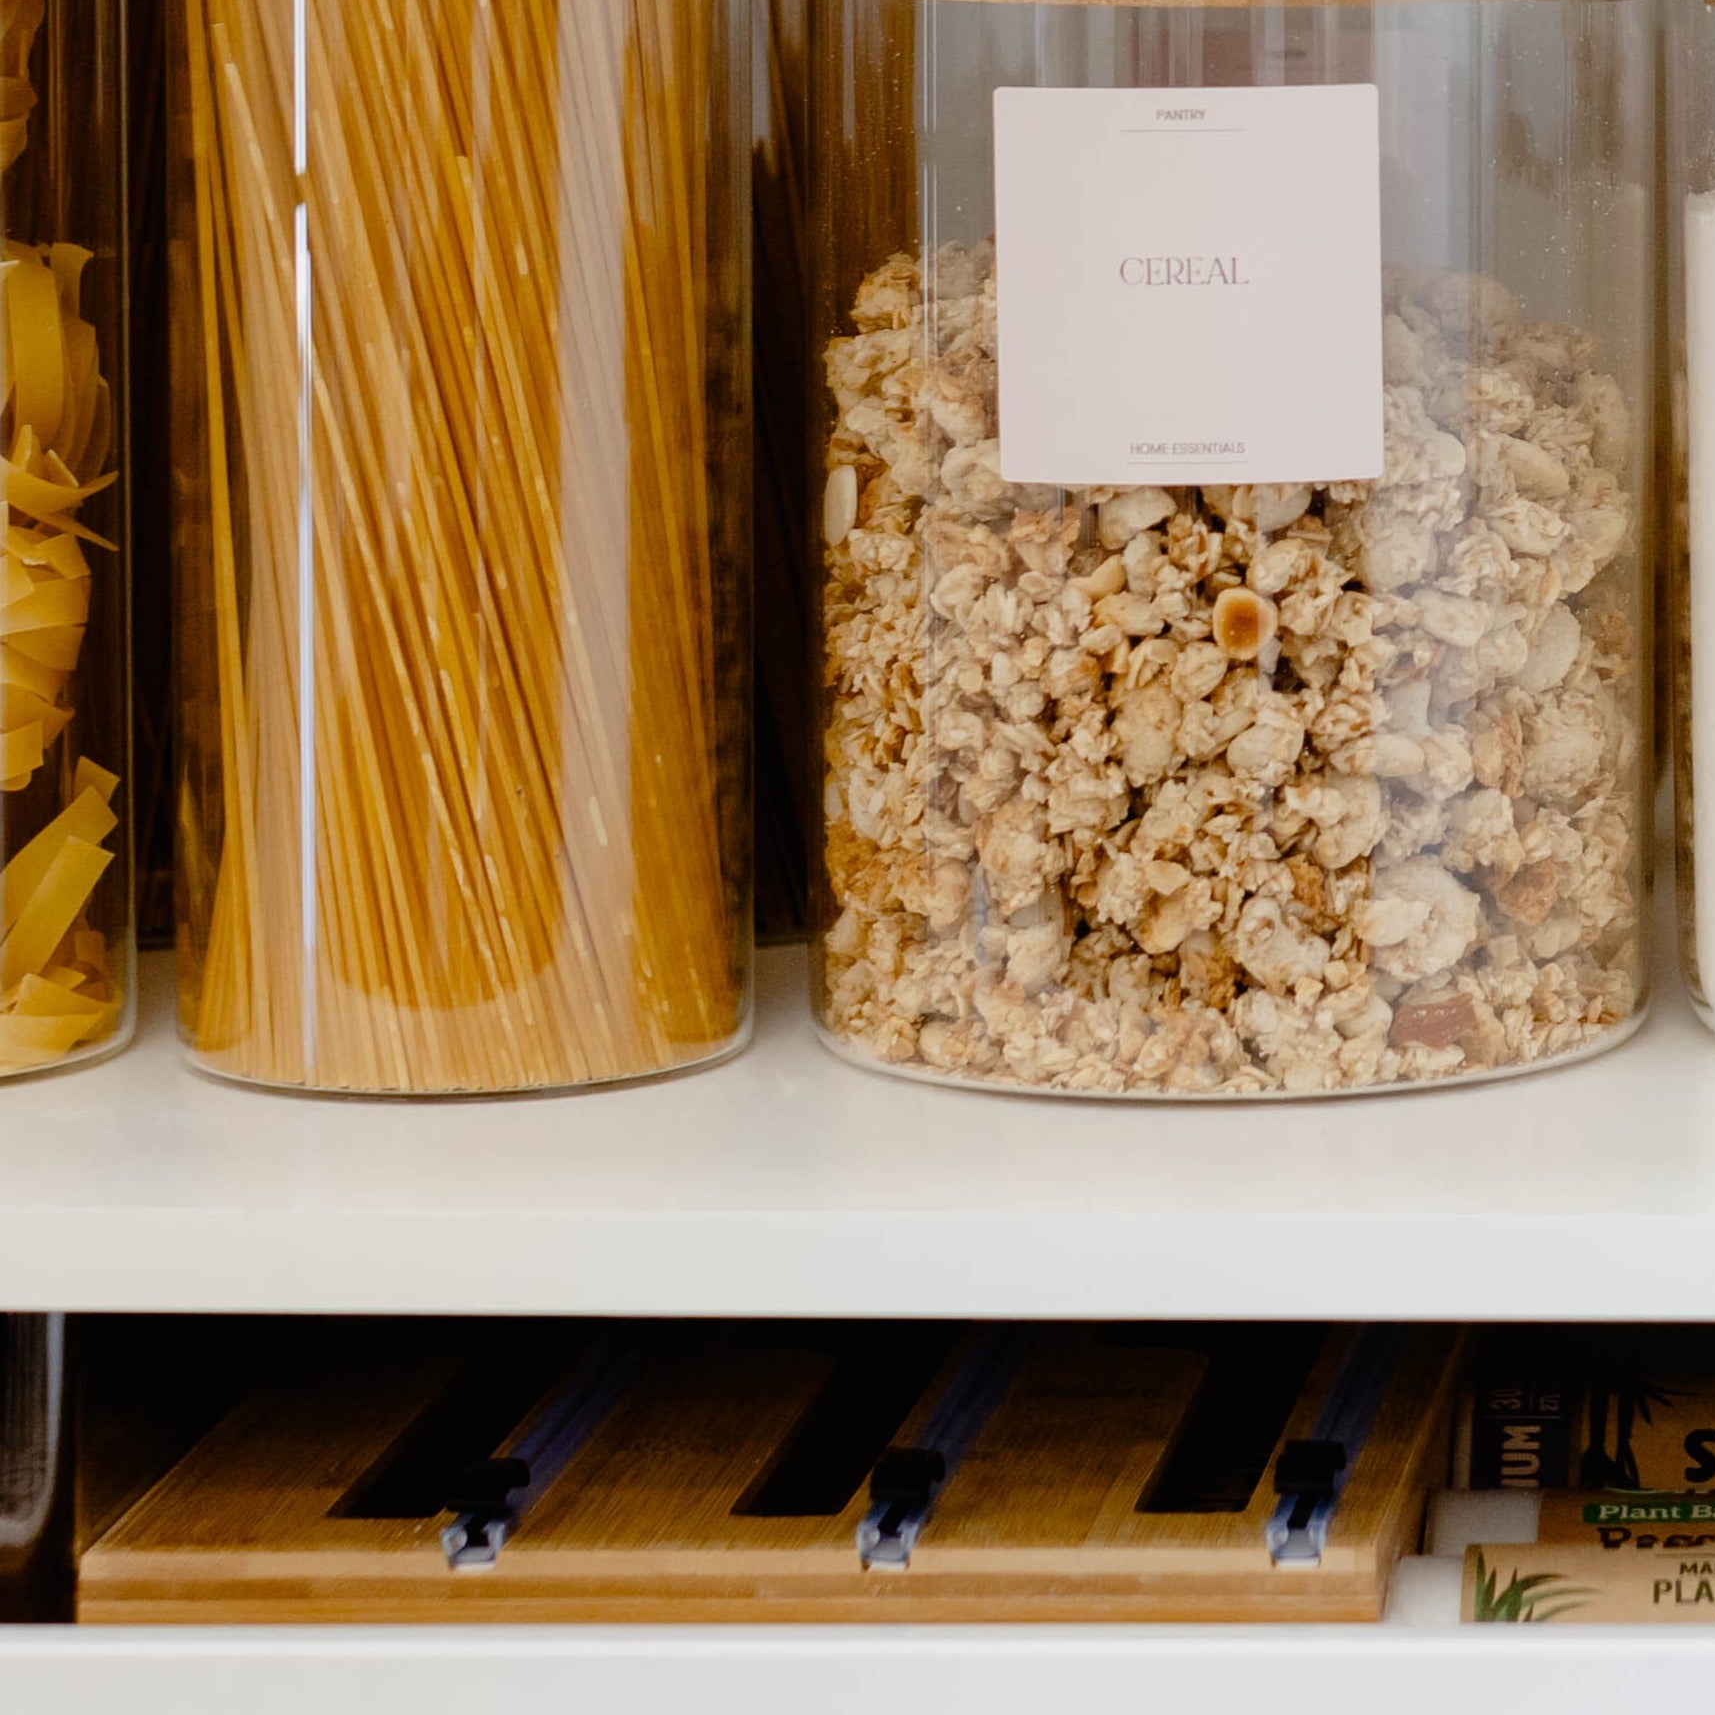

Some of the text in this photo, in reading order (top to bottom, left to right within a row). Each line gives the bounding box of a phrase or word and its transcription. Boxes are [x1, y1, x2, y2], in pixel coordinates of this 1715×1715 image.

[1156, 108, 1206, 121] PANTRY
[1119, 257, 1250, 286] CEREAL
[1130, 442, 1246, 455] HOME ESSENTIALS
[1599, 1504, 1682, 1520] Plant
